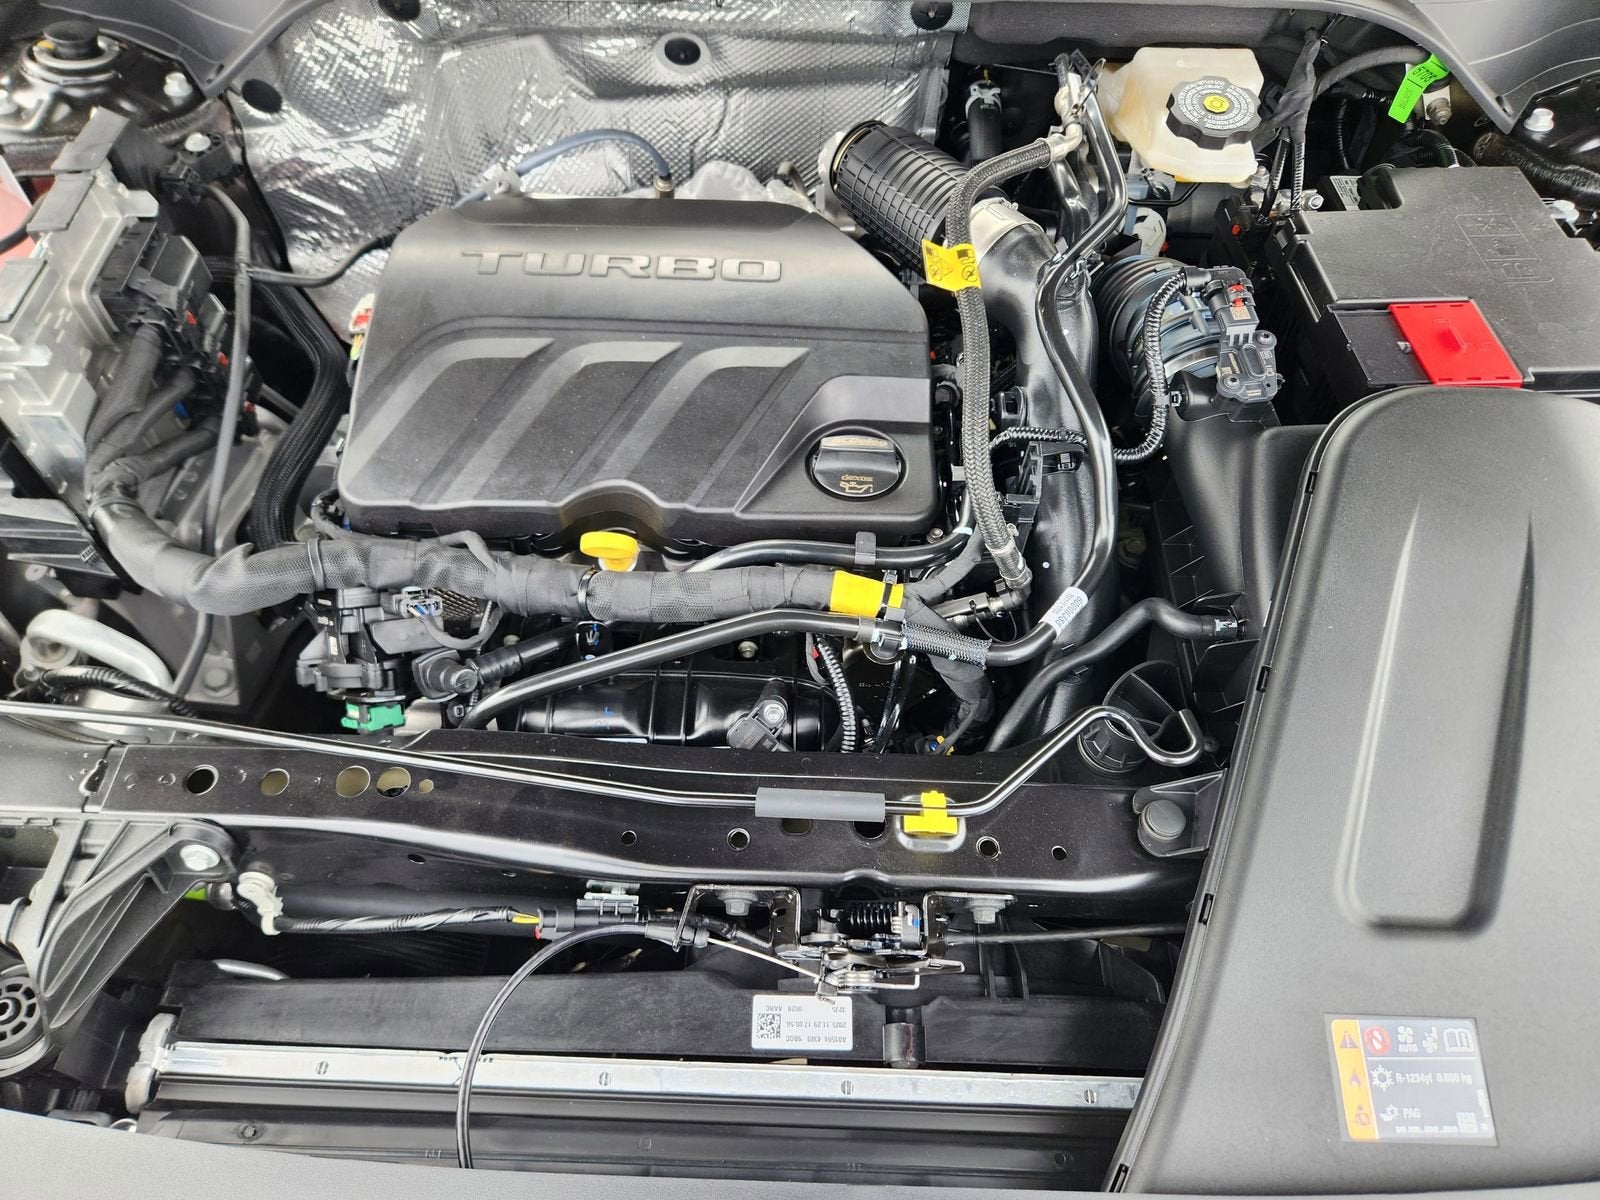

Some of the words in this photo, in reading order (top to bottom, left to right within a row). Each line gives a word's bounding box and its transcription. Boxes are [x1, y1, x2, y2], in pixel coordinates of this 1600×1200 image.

[461, 251, 782, 282] TURBO
[1398, 1043, 1418, 1053] AUTO
[1395, 1072, 1433, 1085] R-1234yf
[1402, 1107, 1421, 1119] PAG
